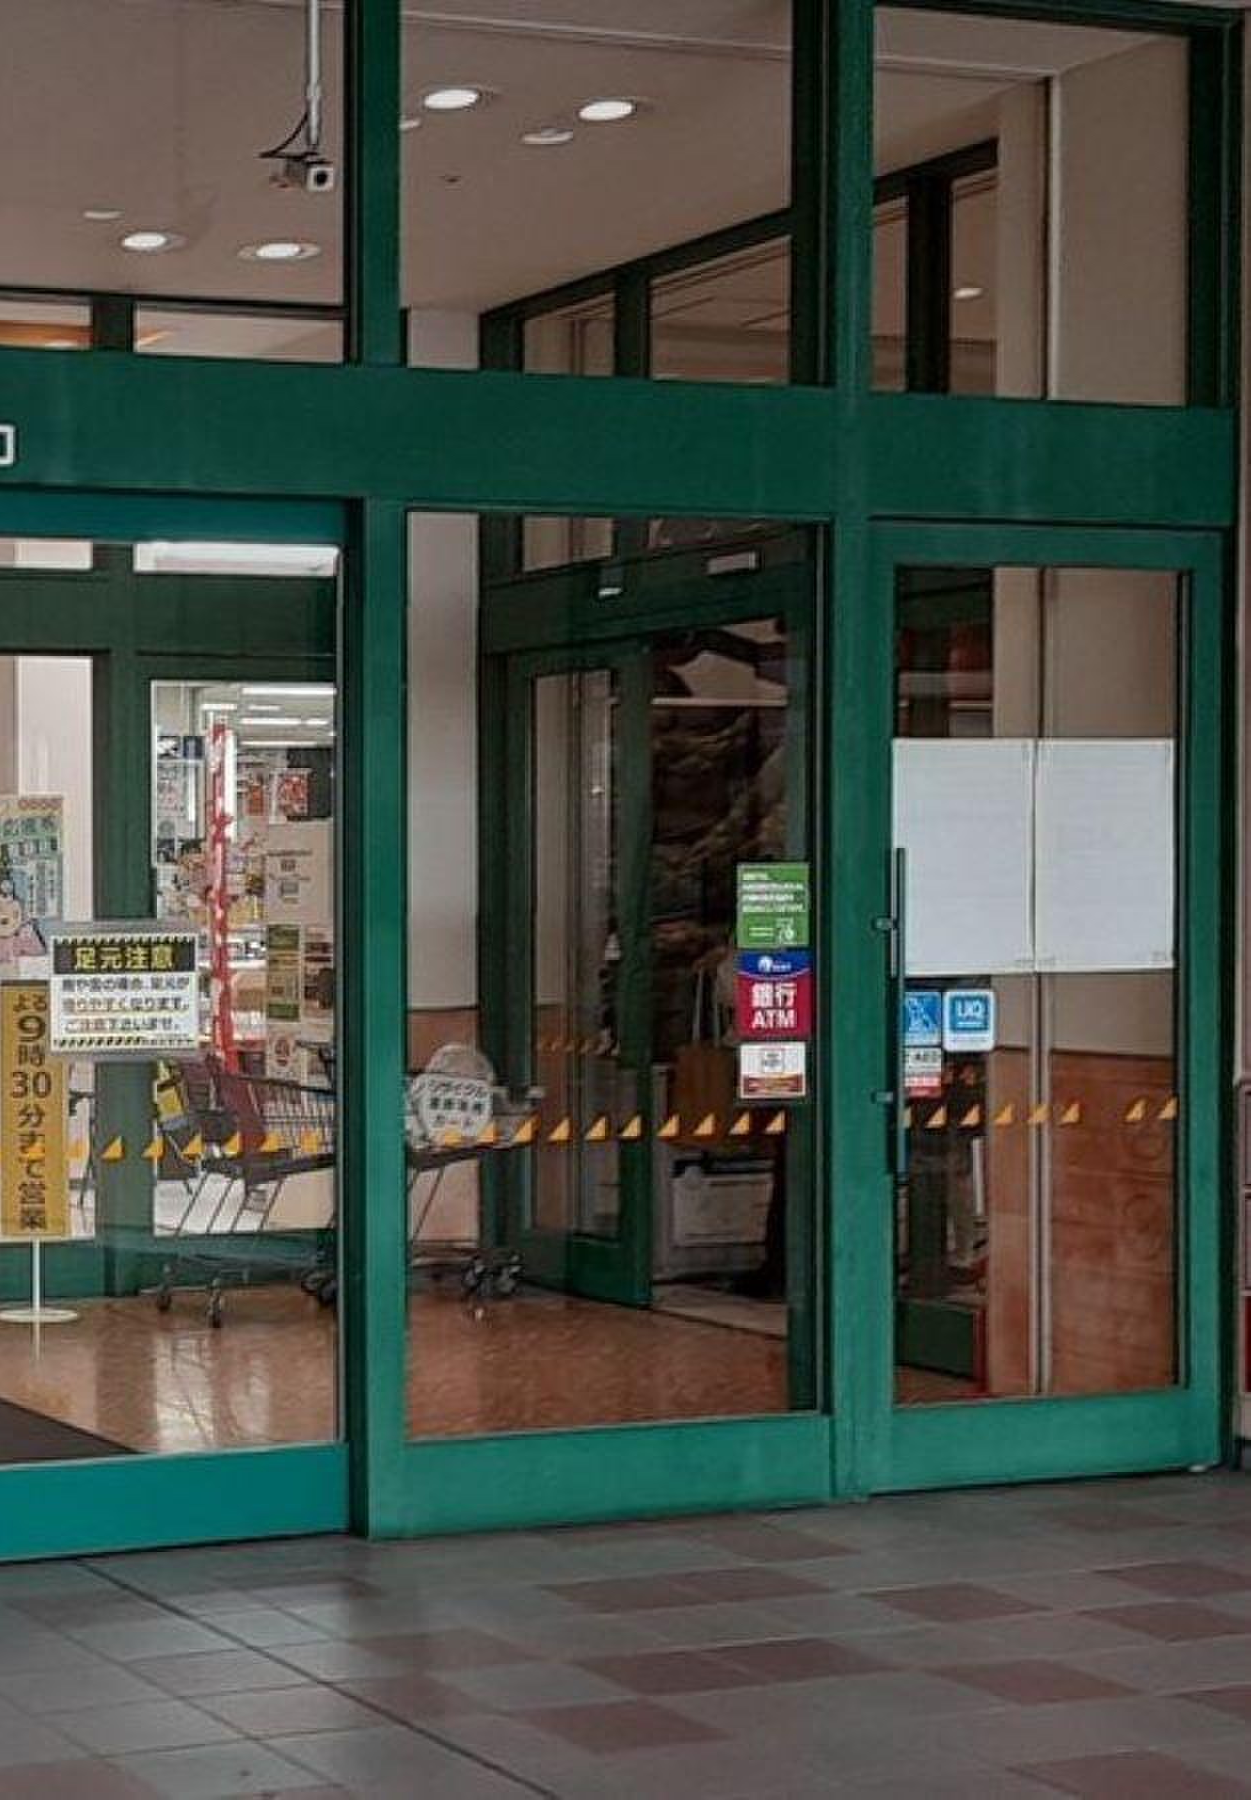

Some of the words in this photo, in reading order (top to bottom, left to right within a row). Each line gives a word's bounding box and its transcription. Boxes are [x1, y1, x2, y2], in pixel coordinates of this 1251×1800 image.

[75, 945, 173, 970] 足元注意
[752, 983, 797, 1007] 銀行
[752, 1009, 796, 1029] ATM
